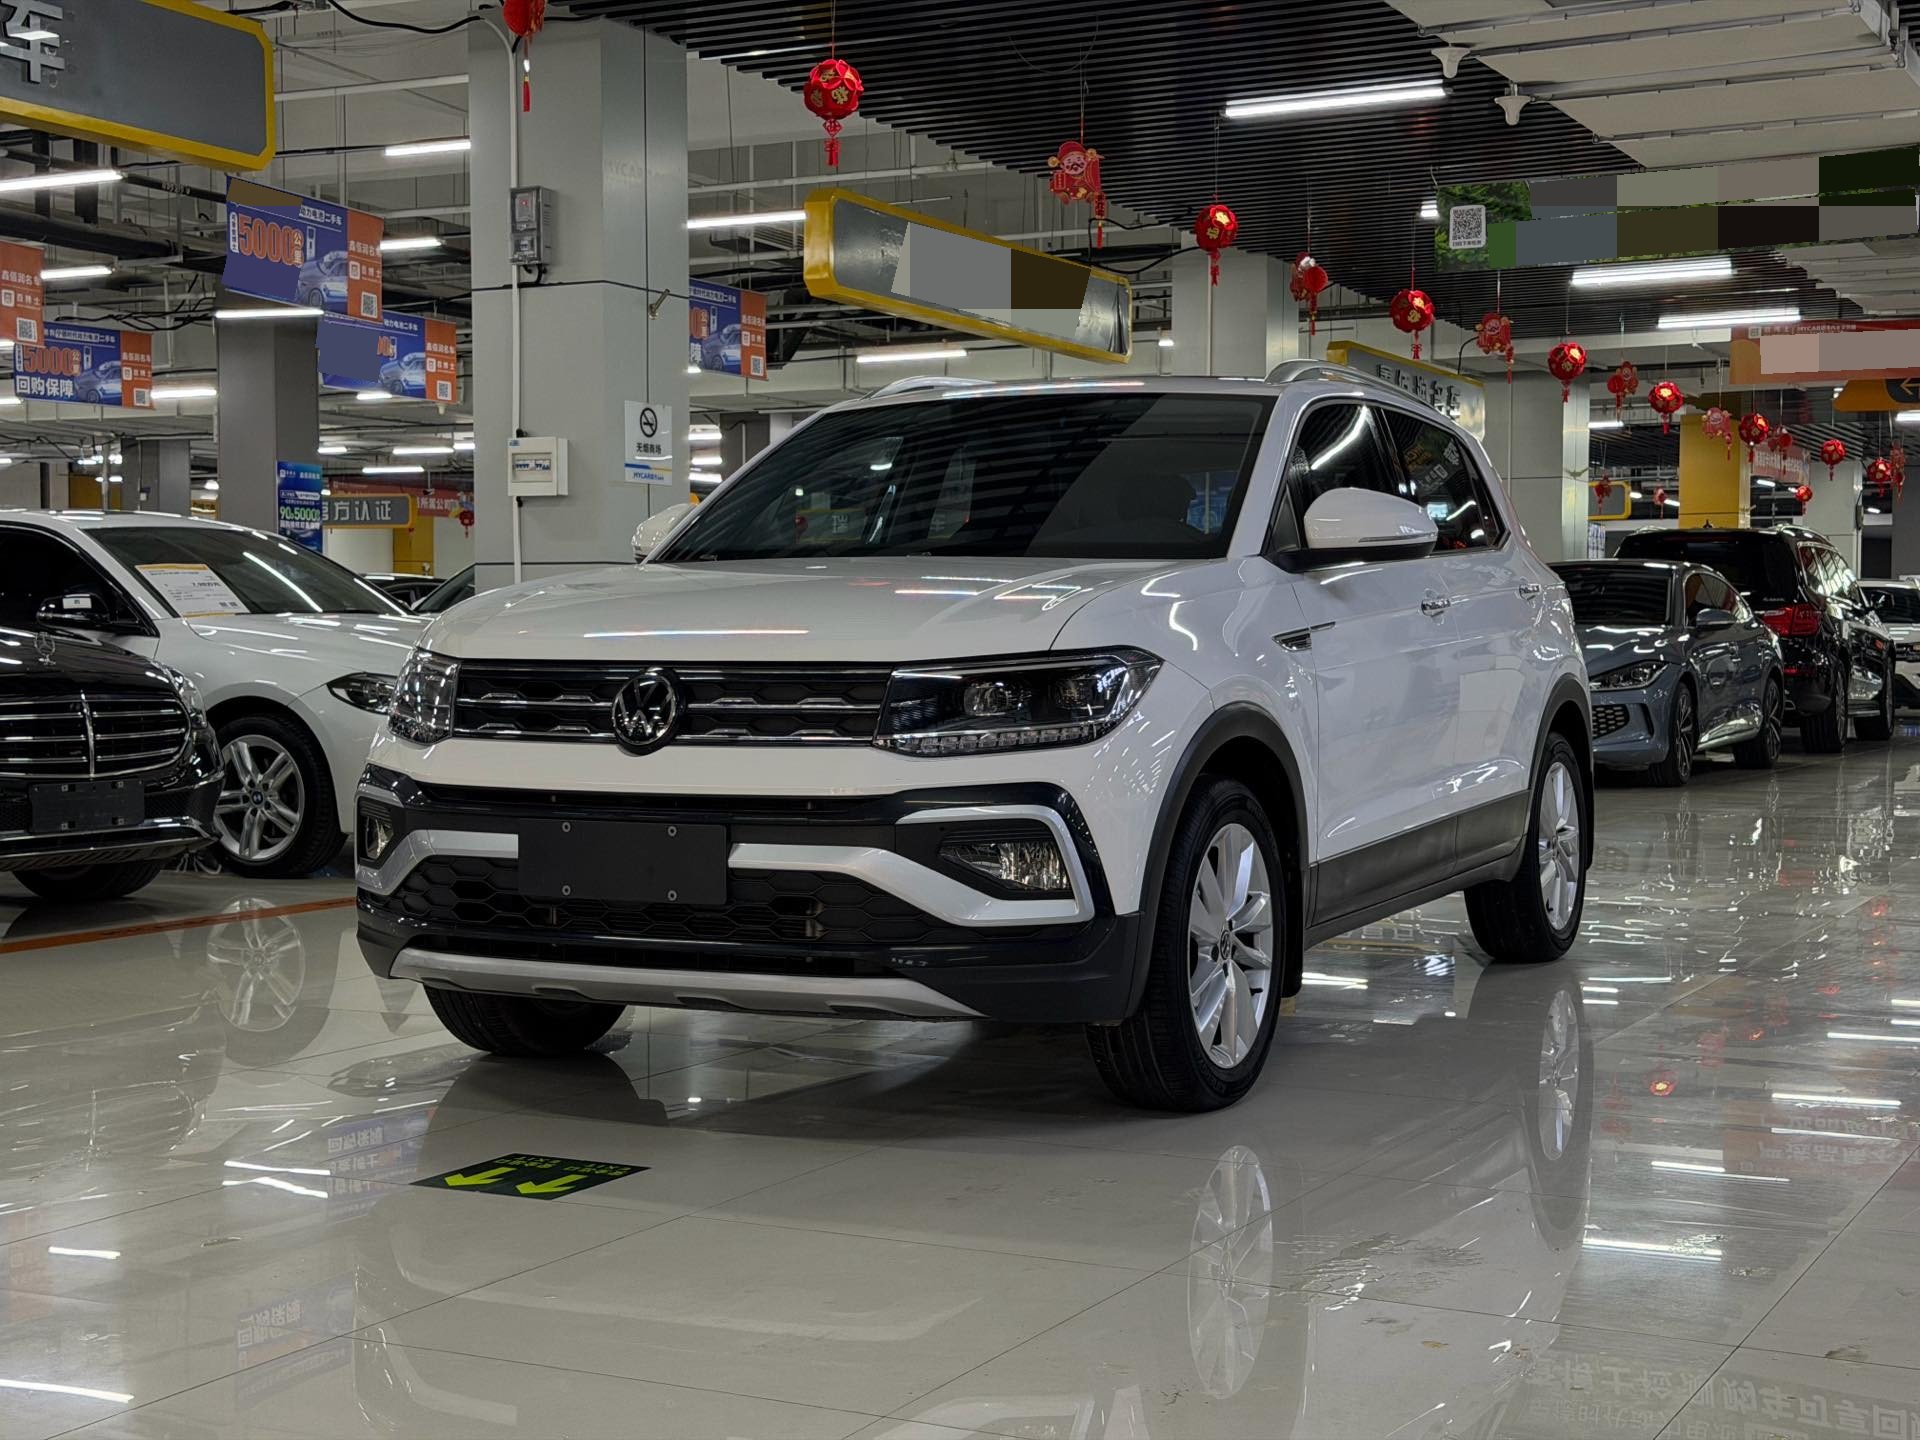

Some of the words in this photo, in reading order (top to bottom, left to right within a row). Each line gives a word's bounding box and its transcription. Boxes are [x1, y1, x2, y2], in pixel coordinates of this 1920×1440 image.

[0, 0, 64, 83] 车
[239, 214, 303, 266] 5000
[23, 346, 76, 376] 5000
[16, 375, 75, 398] 回购保障
[636, 442, 662, 455] 无烟商场
